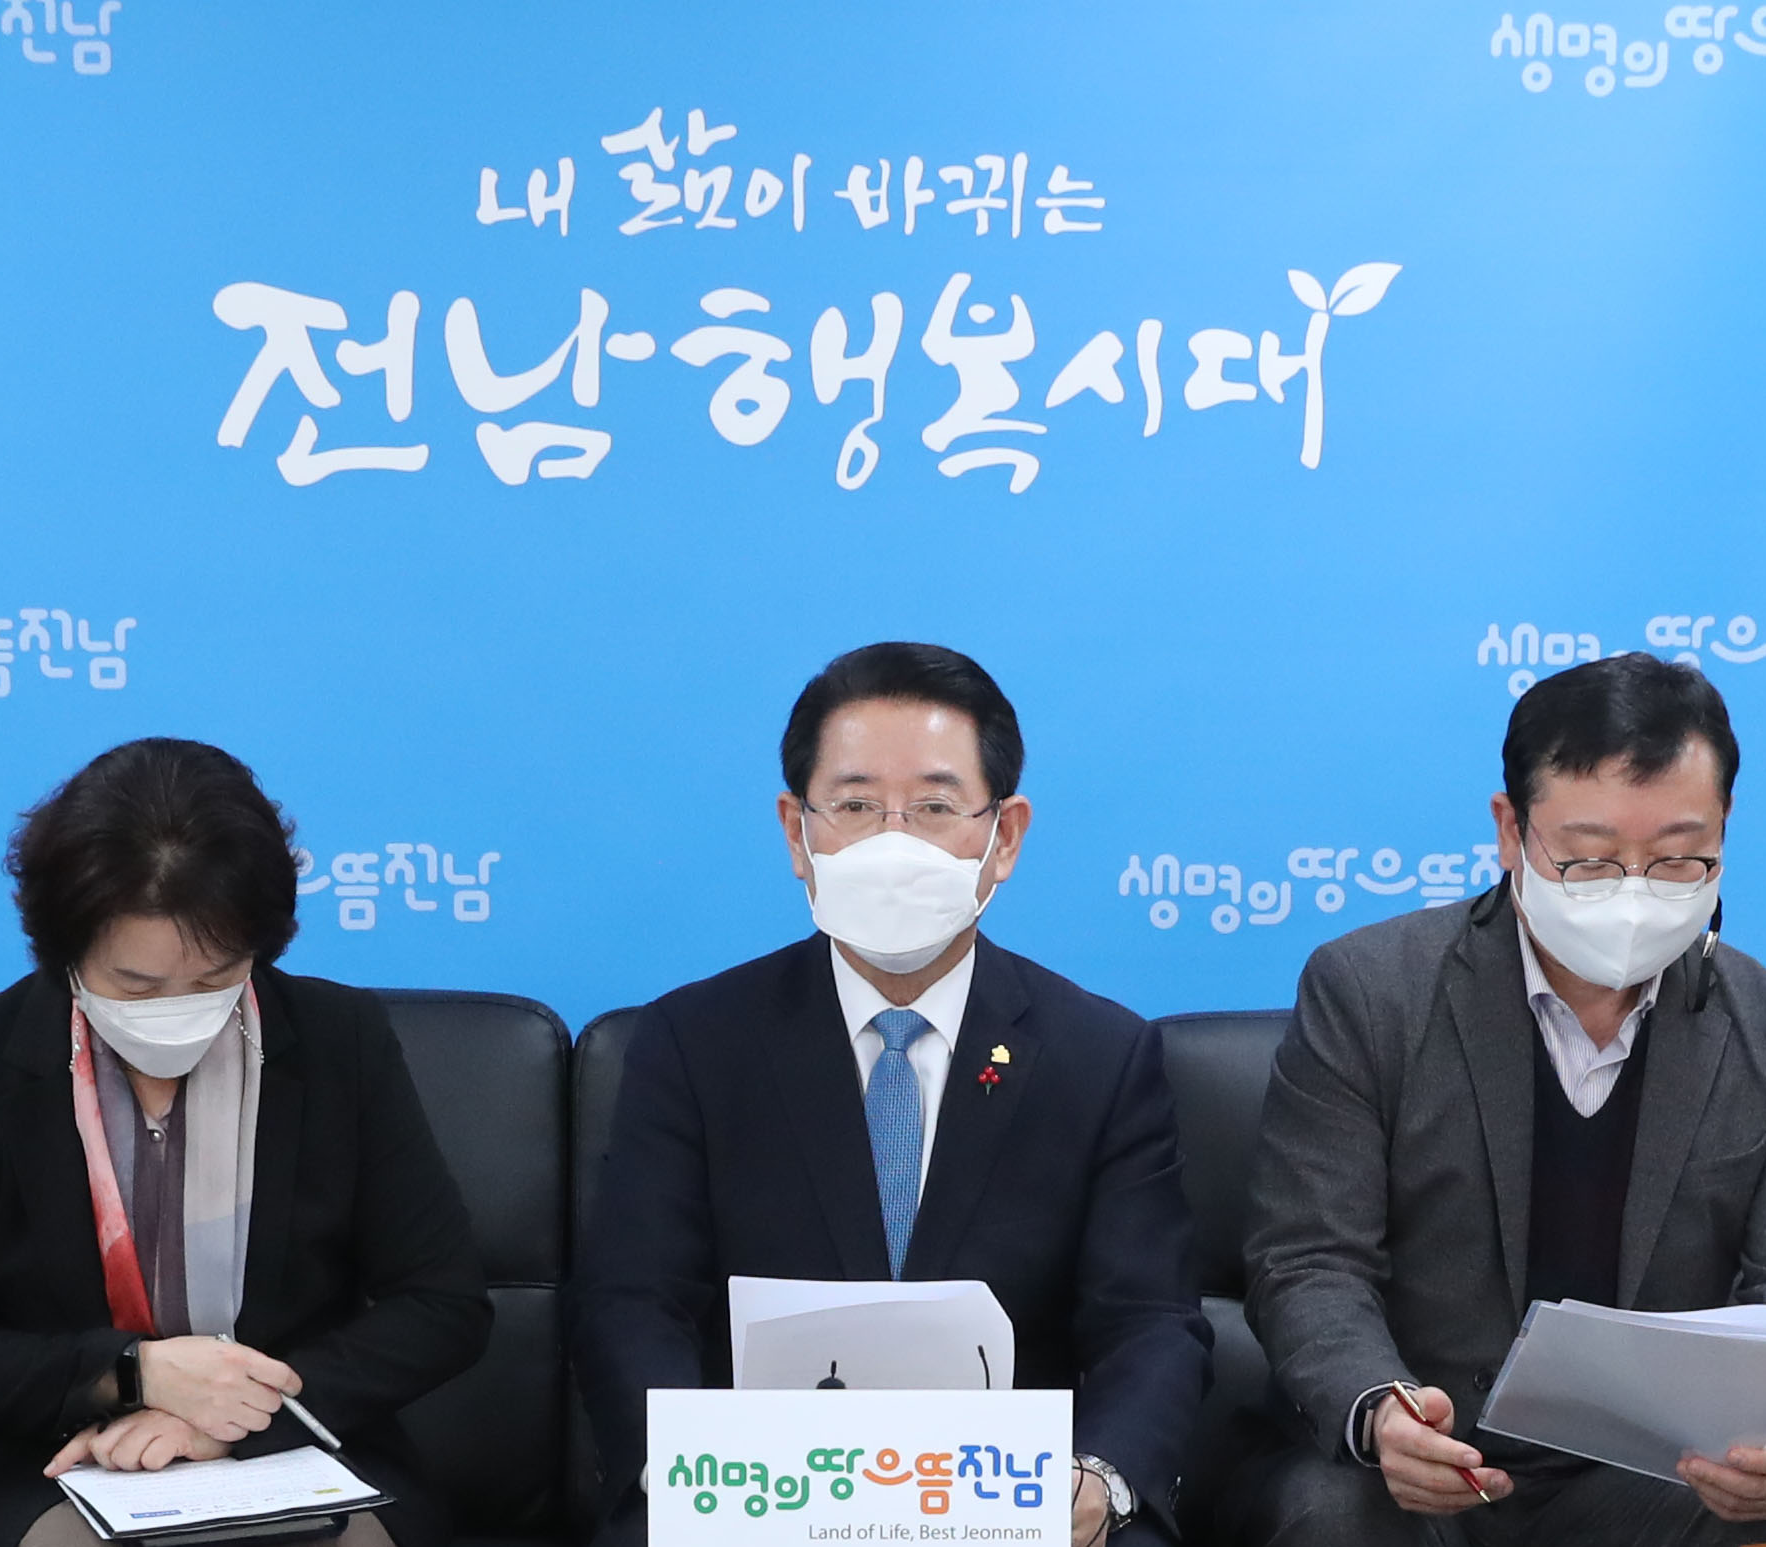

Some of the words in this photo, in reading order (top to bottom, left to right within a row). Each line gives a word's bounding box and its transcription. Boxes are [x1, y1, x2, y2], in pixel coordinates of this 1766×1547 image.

[476, 157, 577, 237] 내
[601, 107, 813, 236] 삶이
[834, 152, 1107, 239] 바뀌는
[809, 1524, 851, 1540] Land
[857, 1524, 875, 1540] of
[879, 1524, 914, 1542] Life,
[920, 1524, 956, 1540] Best
[961, 1525, 1042, 1540] Jeonnam
